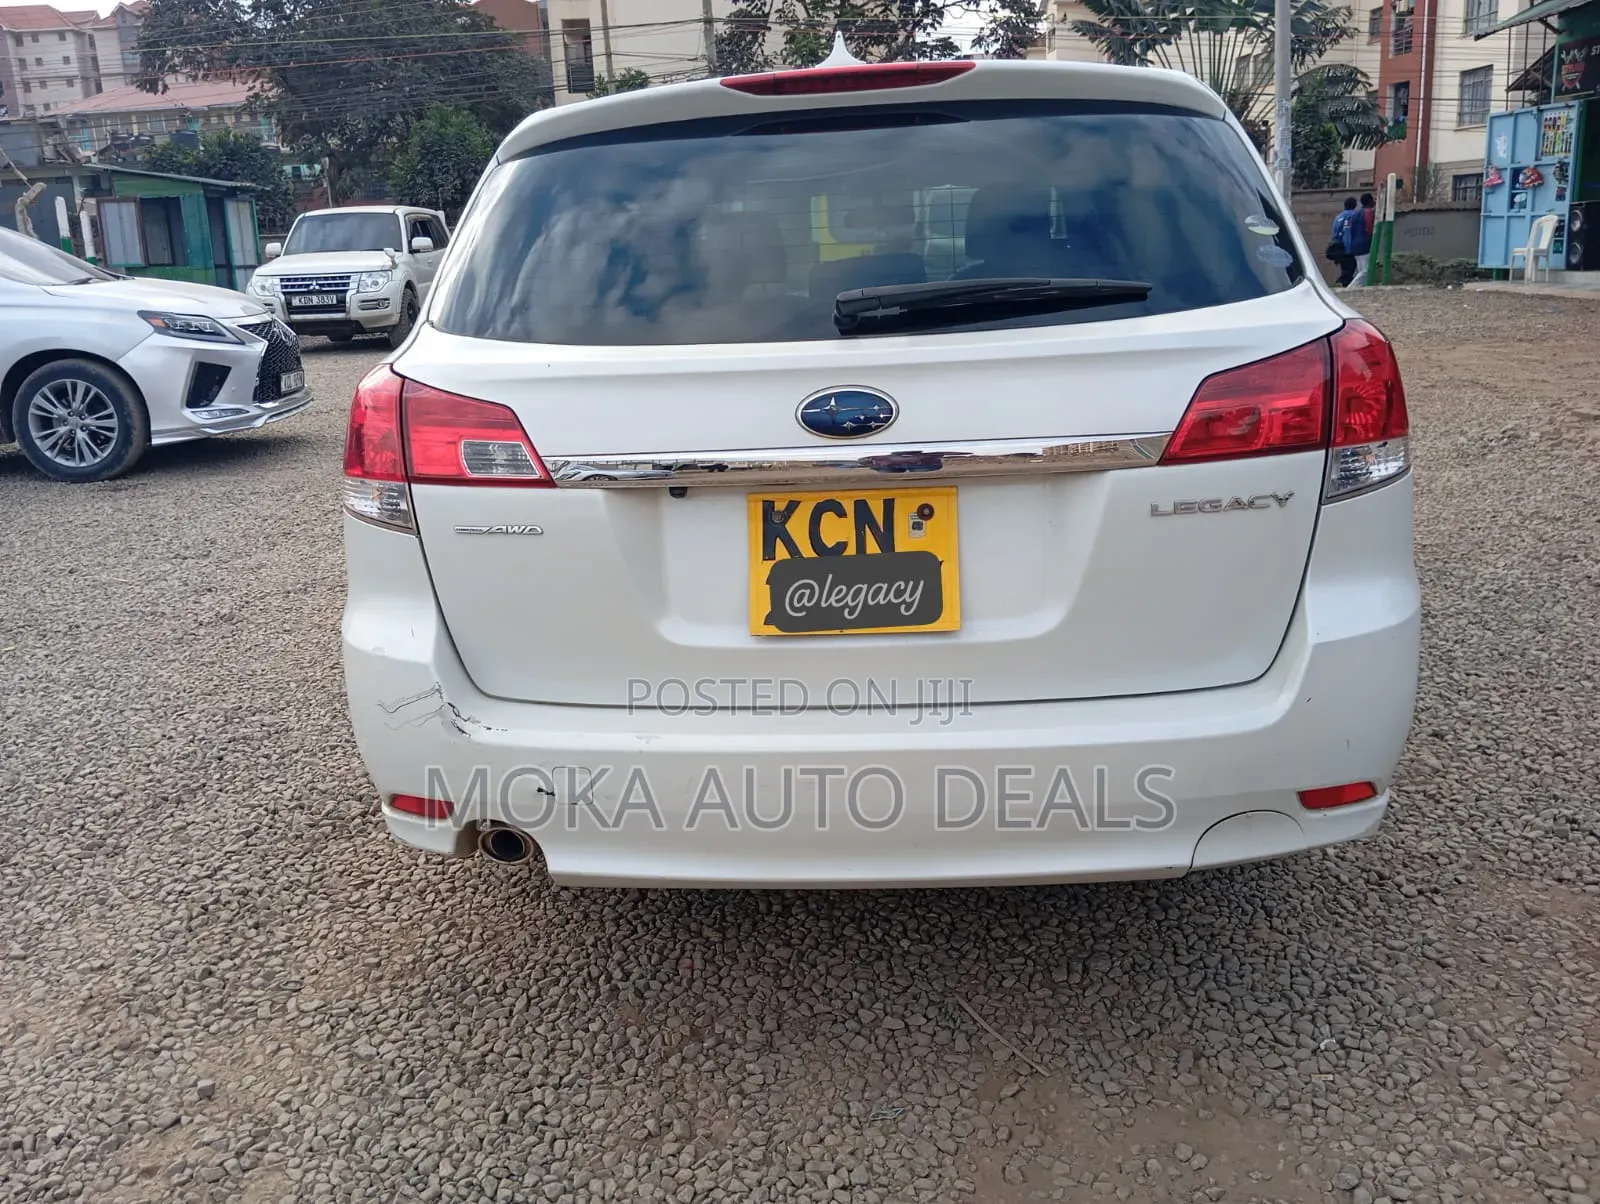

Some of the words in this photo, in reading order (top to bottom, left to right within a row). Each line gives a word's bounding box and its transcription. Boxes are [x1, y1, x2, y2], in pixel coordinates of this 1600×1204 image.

[1150, 490, 1295, 517] LEGACY
[486, 525, 544, 535] AWD
[762, 498, 896, 561] KCN
